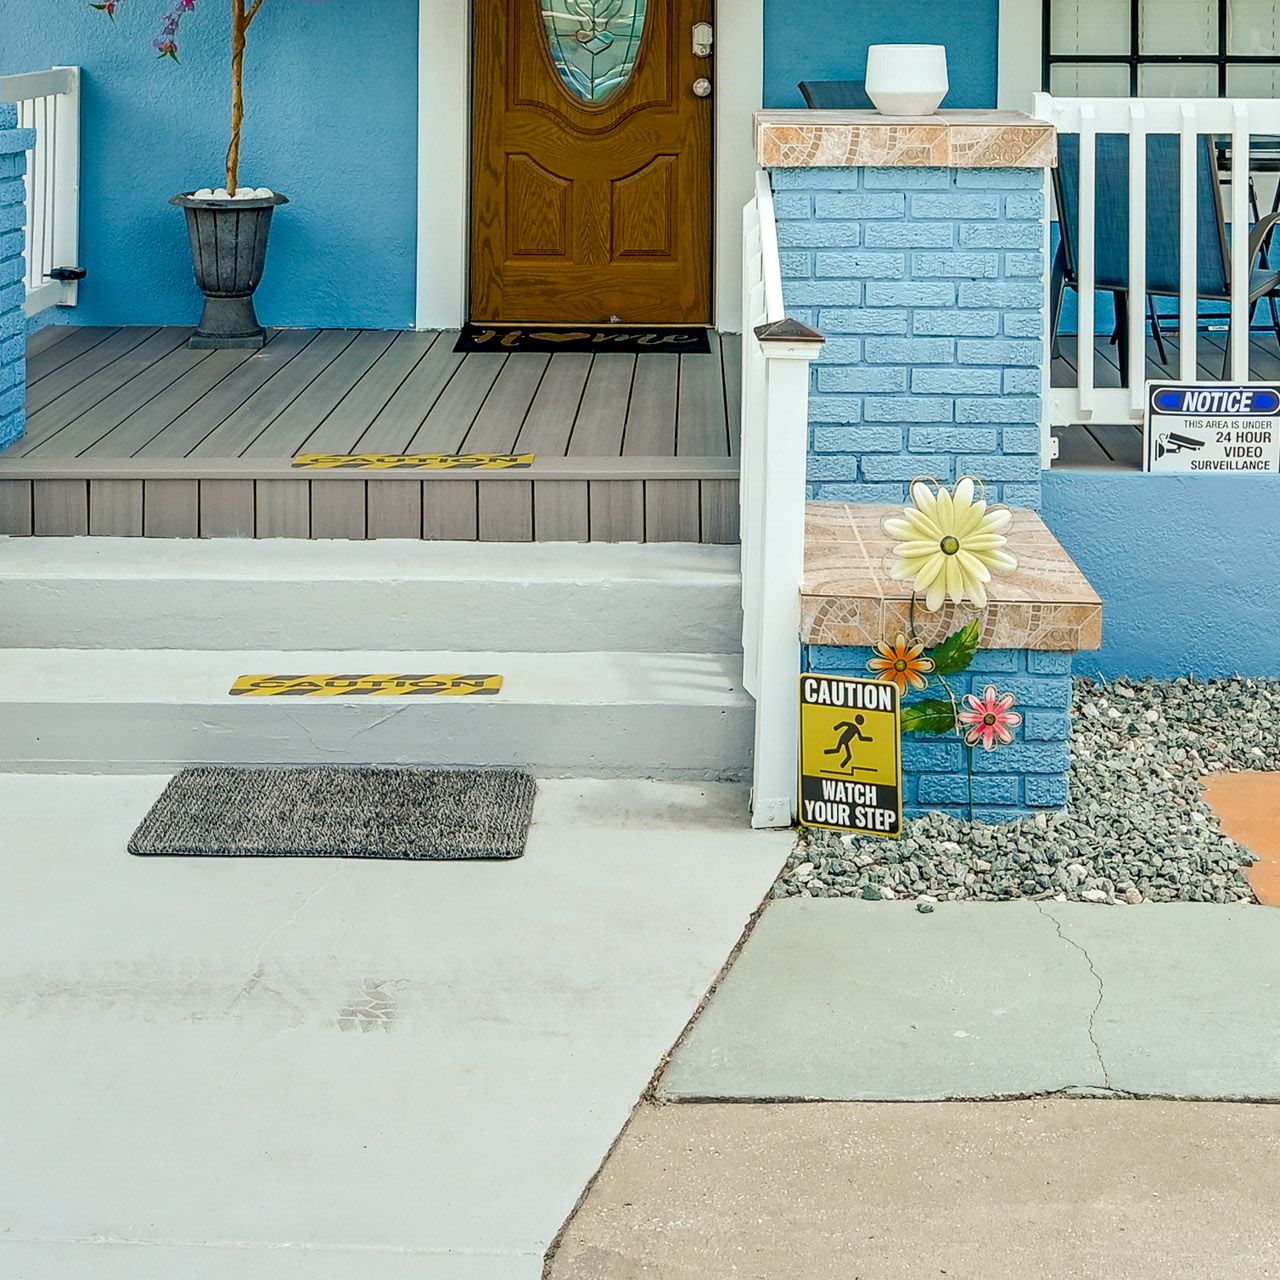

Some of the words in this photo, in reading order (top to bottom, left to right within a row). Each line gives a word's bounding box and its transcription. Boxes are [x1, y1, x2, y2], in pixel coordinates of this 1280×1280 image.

[1182, 391, 1253, 413] NOTICE
[1184, 420, 1203, 429] THIS
[1206, 420, 1229, 429] AREA
[1231, 420, 1240, 429] IS
[1242, 420, 1272, 429] UNDER
[1216, 431, 1232, 443] 24
[1236, 431, 1271, 443] HOUR
[1224, 446, 1263, 458] VIDEO
[1190, 460, 1271, 470] SURVEILLANCE
[250, 680, 485, 688] CAUTION
[804, 678, 892, 711] CAUTION
[822, 779, 878, 806] WATCH
[804, 799, 850, 826] YOUR
[855, 806, 896, 831] STEP
